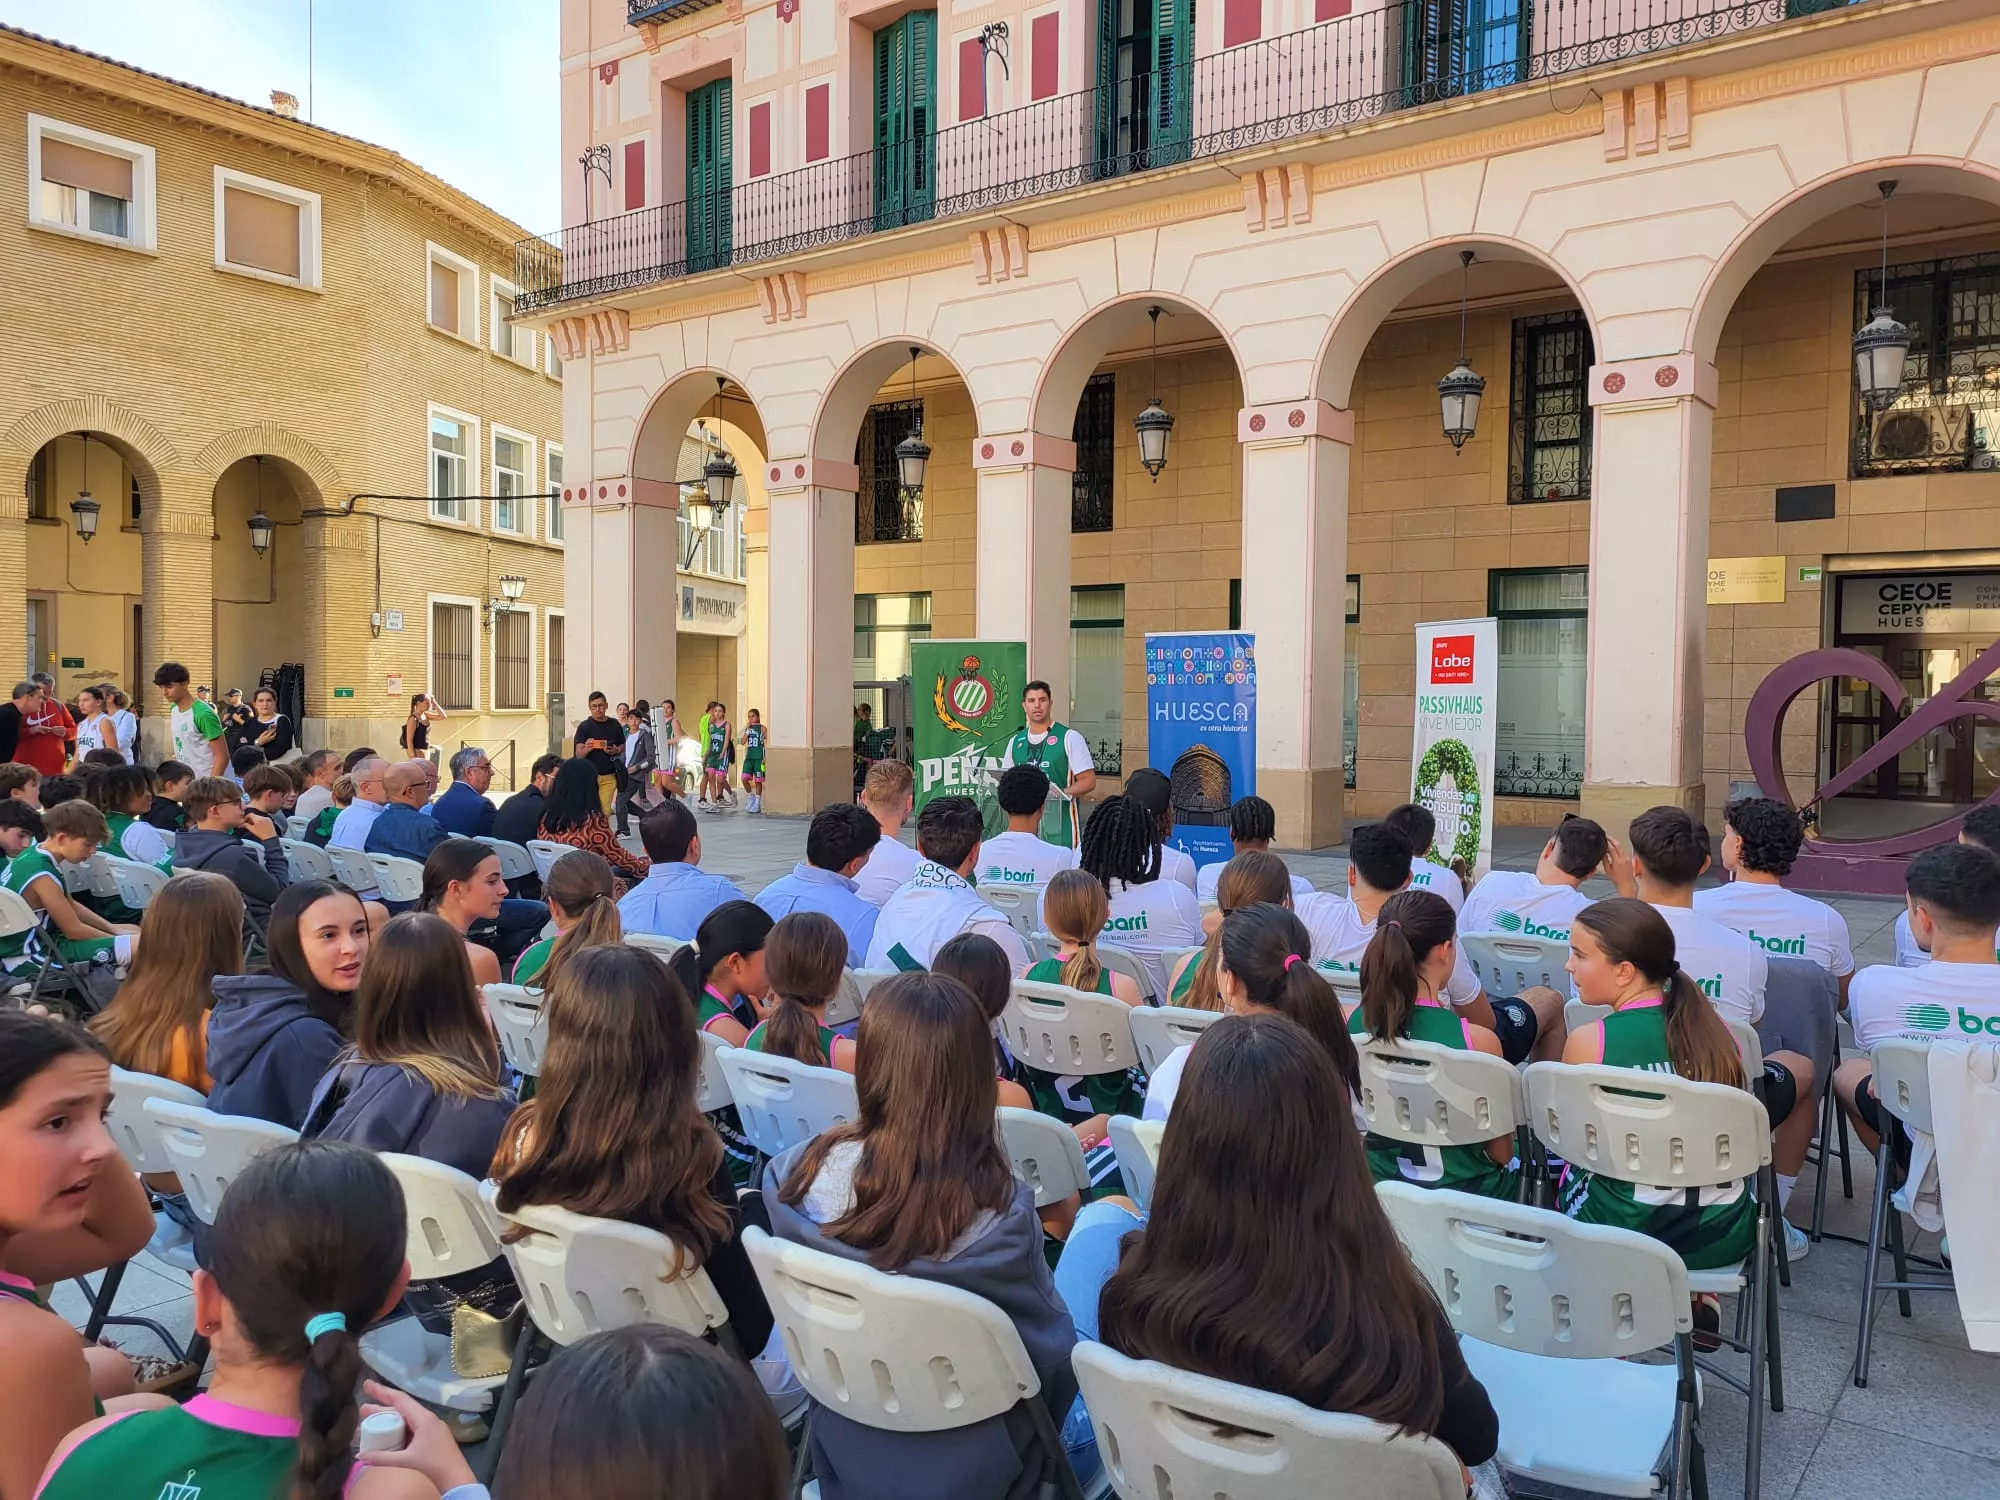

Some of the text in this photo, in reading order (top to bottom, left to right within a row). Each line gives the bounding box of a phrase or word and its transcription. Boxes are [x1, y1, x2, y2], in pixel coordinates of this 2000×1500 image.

[1709, 571, 1725, 580] OE
[1879, 583, 1952, 601] CEOE
[696, 596, 736, 618] PROVINCIAL
[1878, 603, 1951, 615] CEPYME
[1878, 617, 1951, 628] HUESCA
[1435, 653, 1470, 668] Lobe
[1155, 702, 1248, 721] HUESCA
[1420, 695, 1483, 715] PASSIVHAUS
[1222, 723, 1248, 732] historia
[1420, 716, 1482, 731] VIVE MEJOR
[748, 737, 759, 747] 28
[918, 742, 1004, 793] PEÑA
[945, 787, 992, 797] HUESCA
[1421, 785, 1476, 802] Viviendas de
[1421, 799, 1474, 816] consumo
[914, 863, 967, 890] esca
[1004, 866, 1035, 882] barri
[1411, 872, 1432, 885] rri
[1524, 916, 1570, 941] barri
